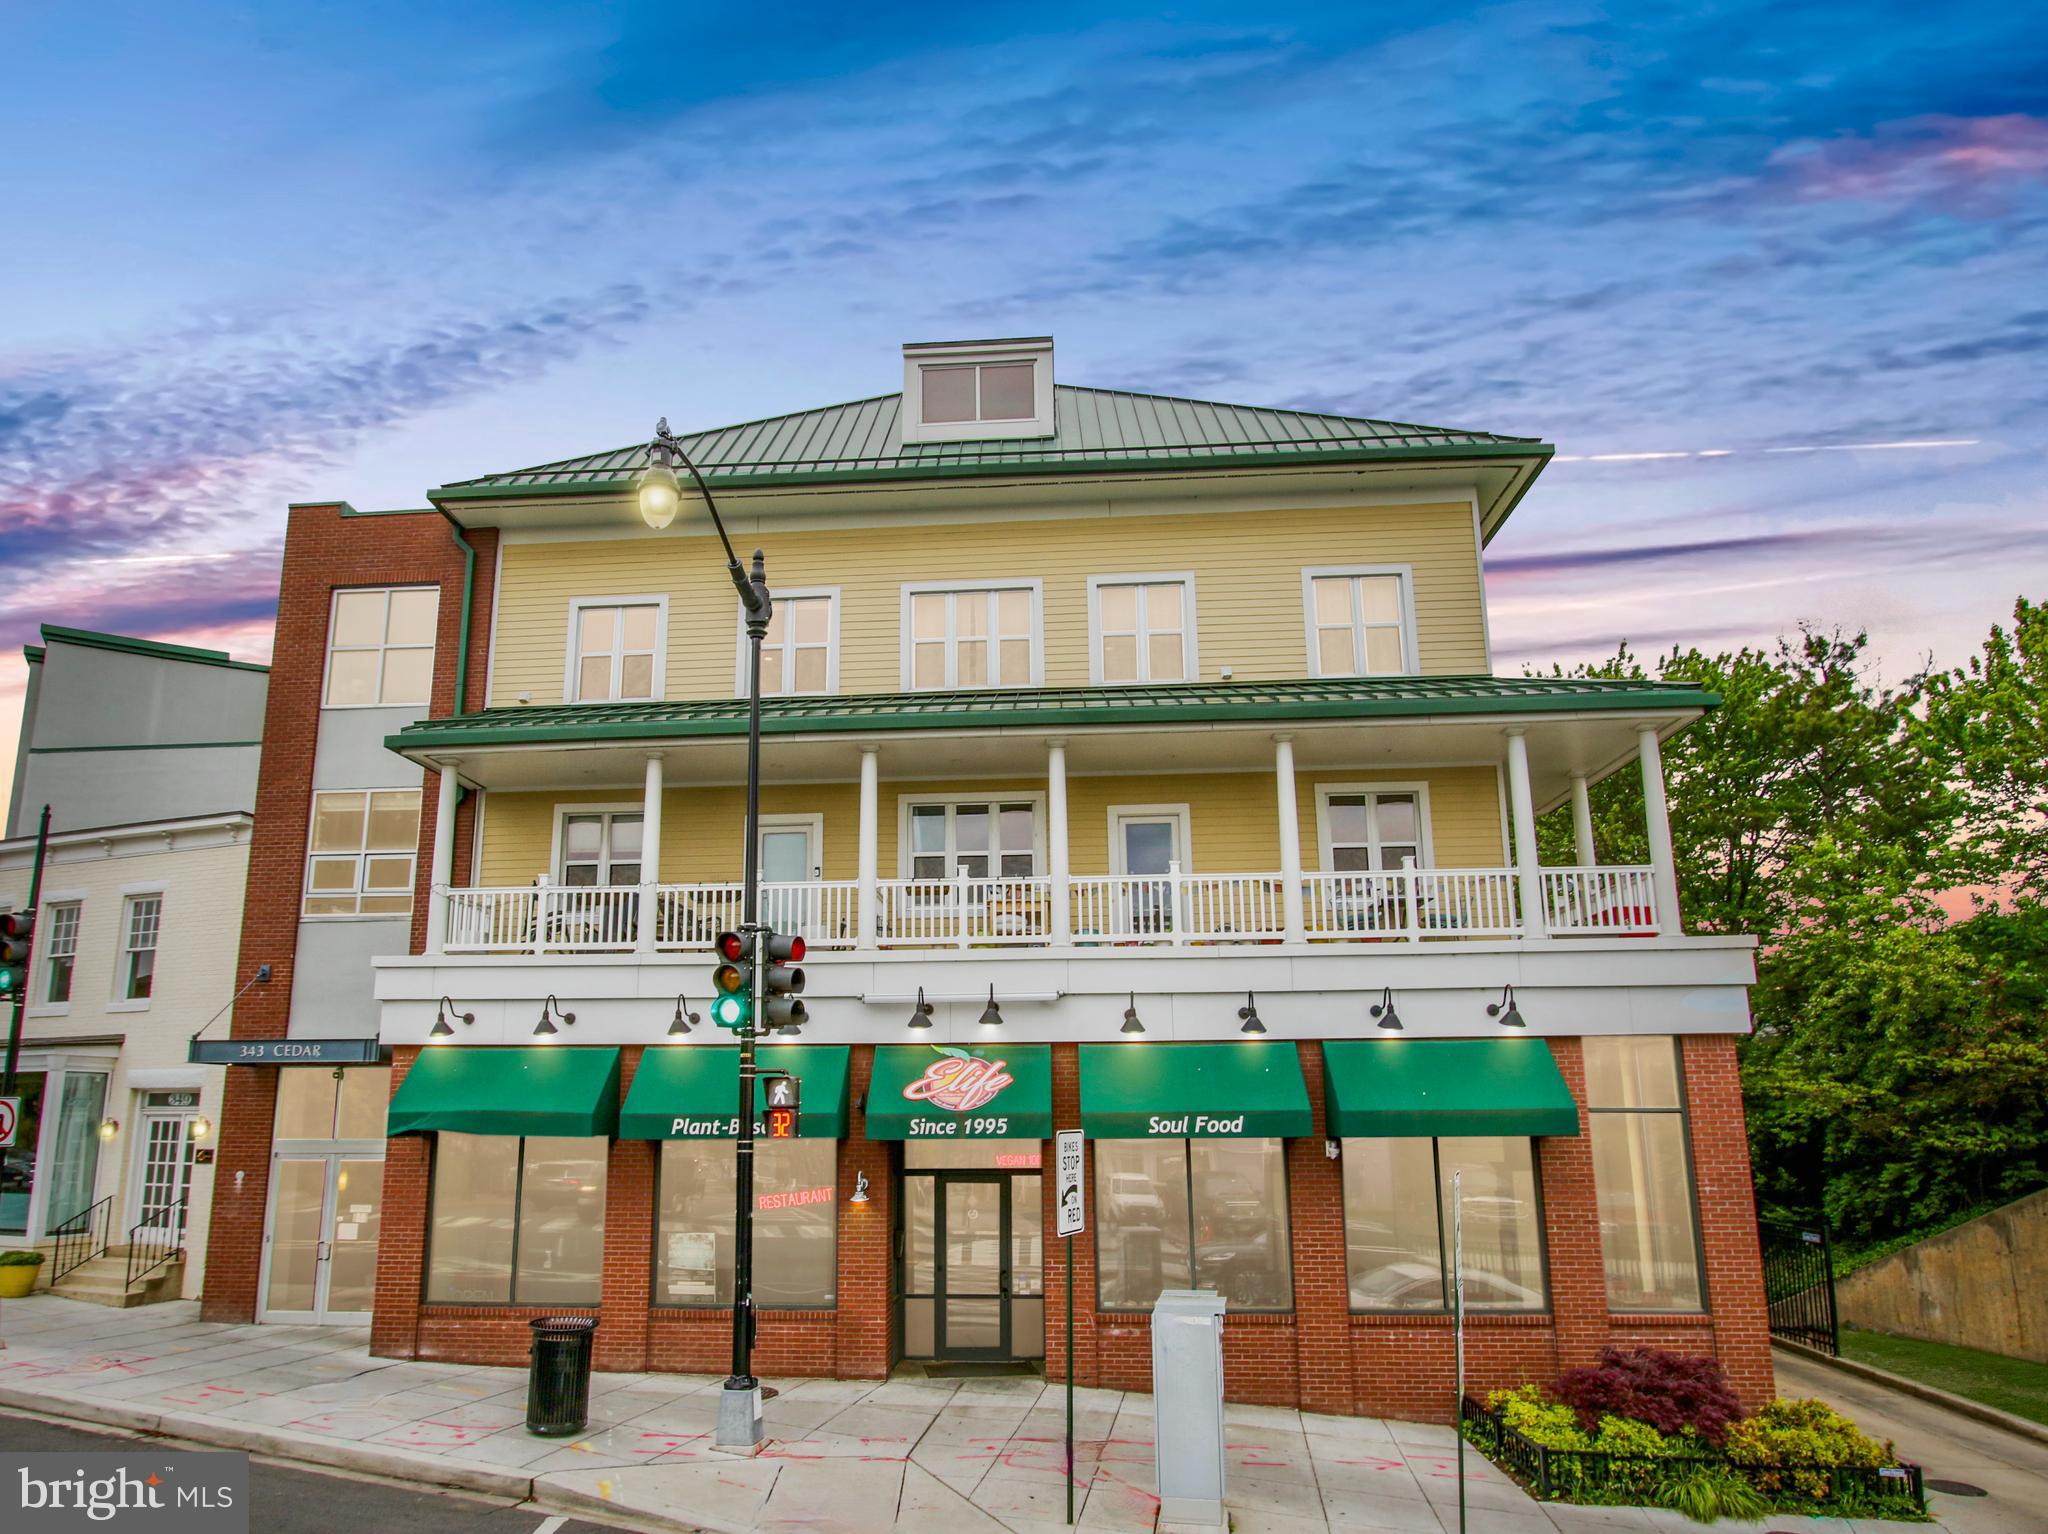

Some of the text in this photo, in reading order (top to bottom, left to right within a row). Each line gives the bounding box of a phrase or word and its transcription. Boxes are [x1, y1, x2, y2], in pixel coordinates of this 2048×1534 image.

[240, 1044, 321, 1057] 343 CEDAR
[903, 1059, 1014, 1111] Elife
[772, 1112, 792, 1137] 32
[909, 1117, 1008, 1135] Since 1995
[1148, 1115, 1244, 1133] Soul Food
[1064, 1141, 1079, 1153] BIKES
[996, 1154, 1026, 1166] VEGAN
[1062, 1155, 1080, 1171] STOP
[759, 1188, 833, 1210] RESTAURANT
[1067, 1207, 1081, 1223] RED
